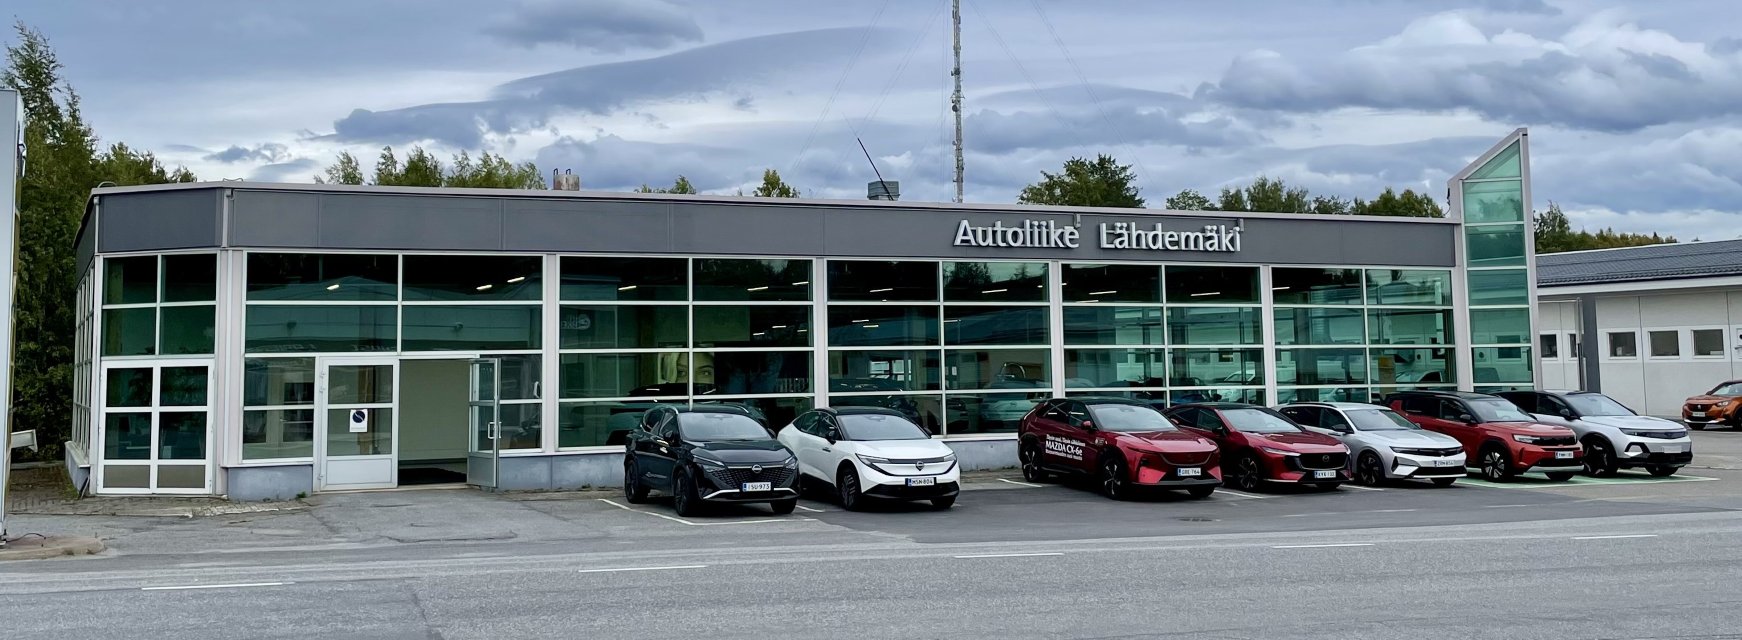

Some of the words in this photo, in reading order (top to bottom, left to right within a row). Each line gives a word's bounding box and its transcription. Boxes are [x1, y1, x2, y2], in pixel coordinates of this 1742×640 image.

[953, 218, 1080, 249] Autoliike
[1100, 221, 1242, 252] Lähdemäki
[1045, 440, 1067, 453] MAZDA
